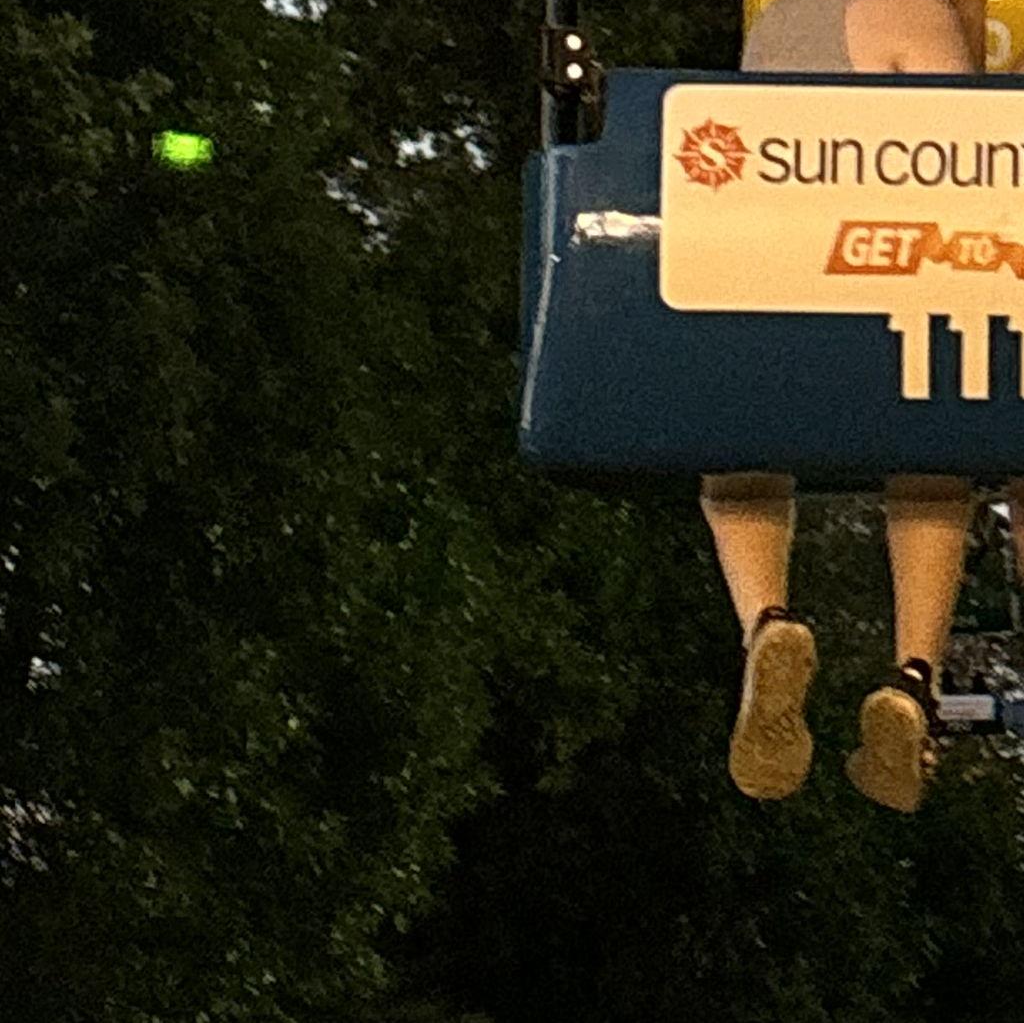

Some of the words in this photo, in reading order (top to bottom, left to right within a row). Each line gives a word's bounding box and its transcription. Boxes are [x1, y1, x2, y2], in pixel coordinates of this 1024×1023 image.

[758, 137, 862, 184] sun
[842, 227, 920, 267] GET
[957, 238, 993, 264] TO
